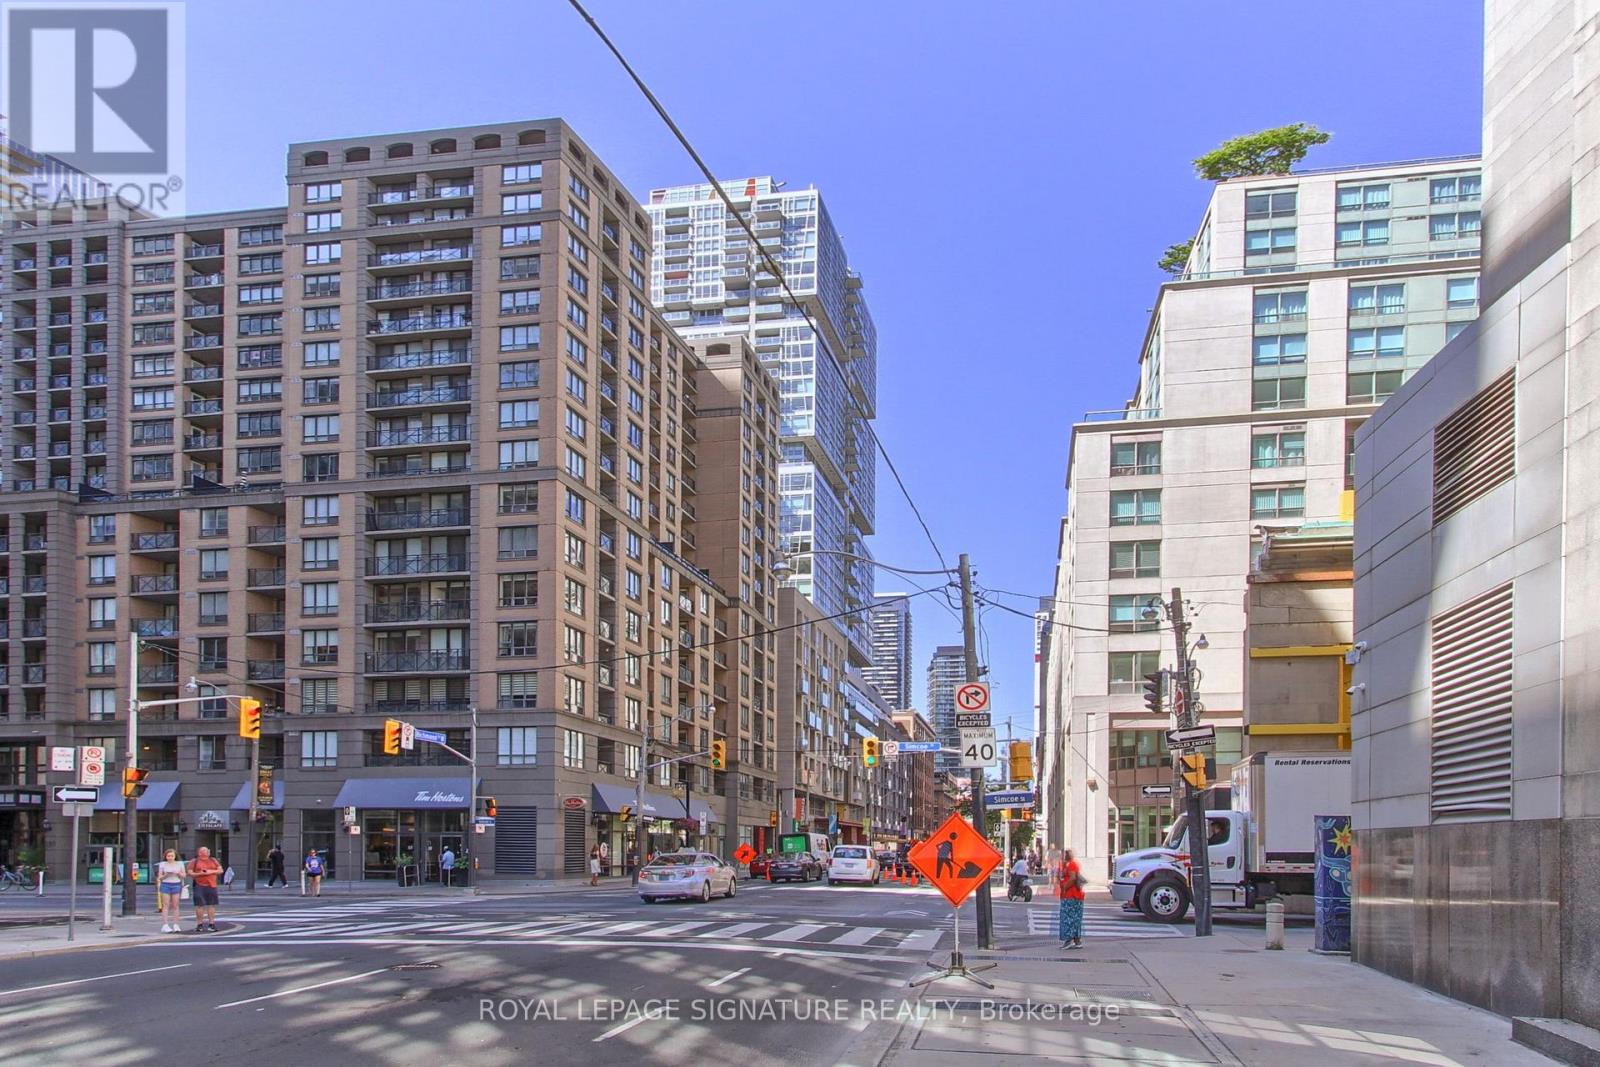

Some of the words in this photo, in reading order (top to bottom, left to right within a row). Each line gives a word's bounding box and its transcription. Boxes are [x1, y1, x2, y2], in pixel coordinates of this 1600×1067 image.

[964, 744, 994, 760] 40
[1300, 758, 1351, 766] Reservations
[414, 791, 431, 802] Tim
[430, 791, 465, 803] Hortons
[993, 796, 1019, 804] Simcoe
